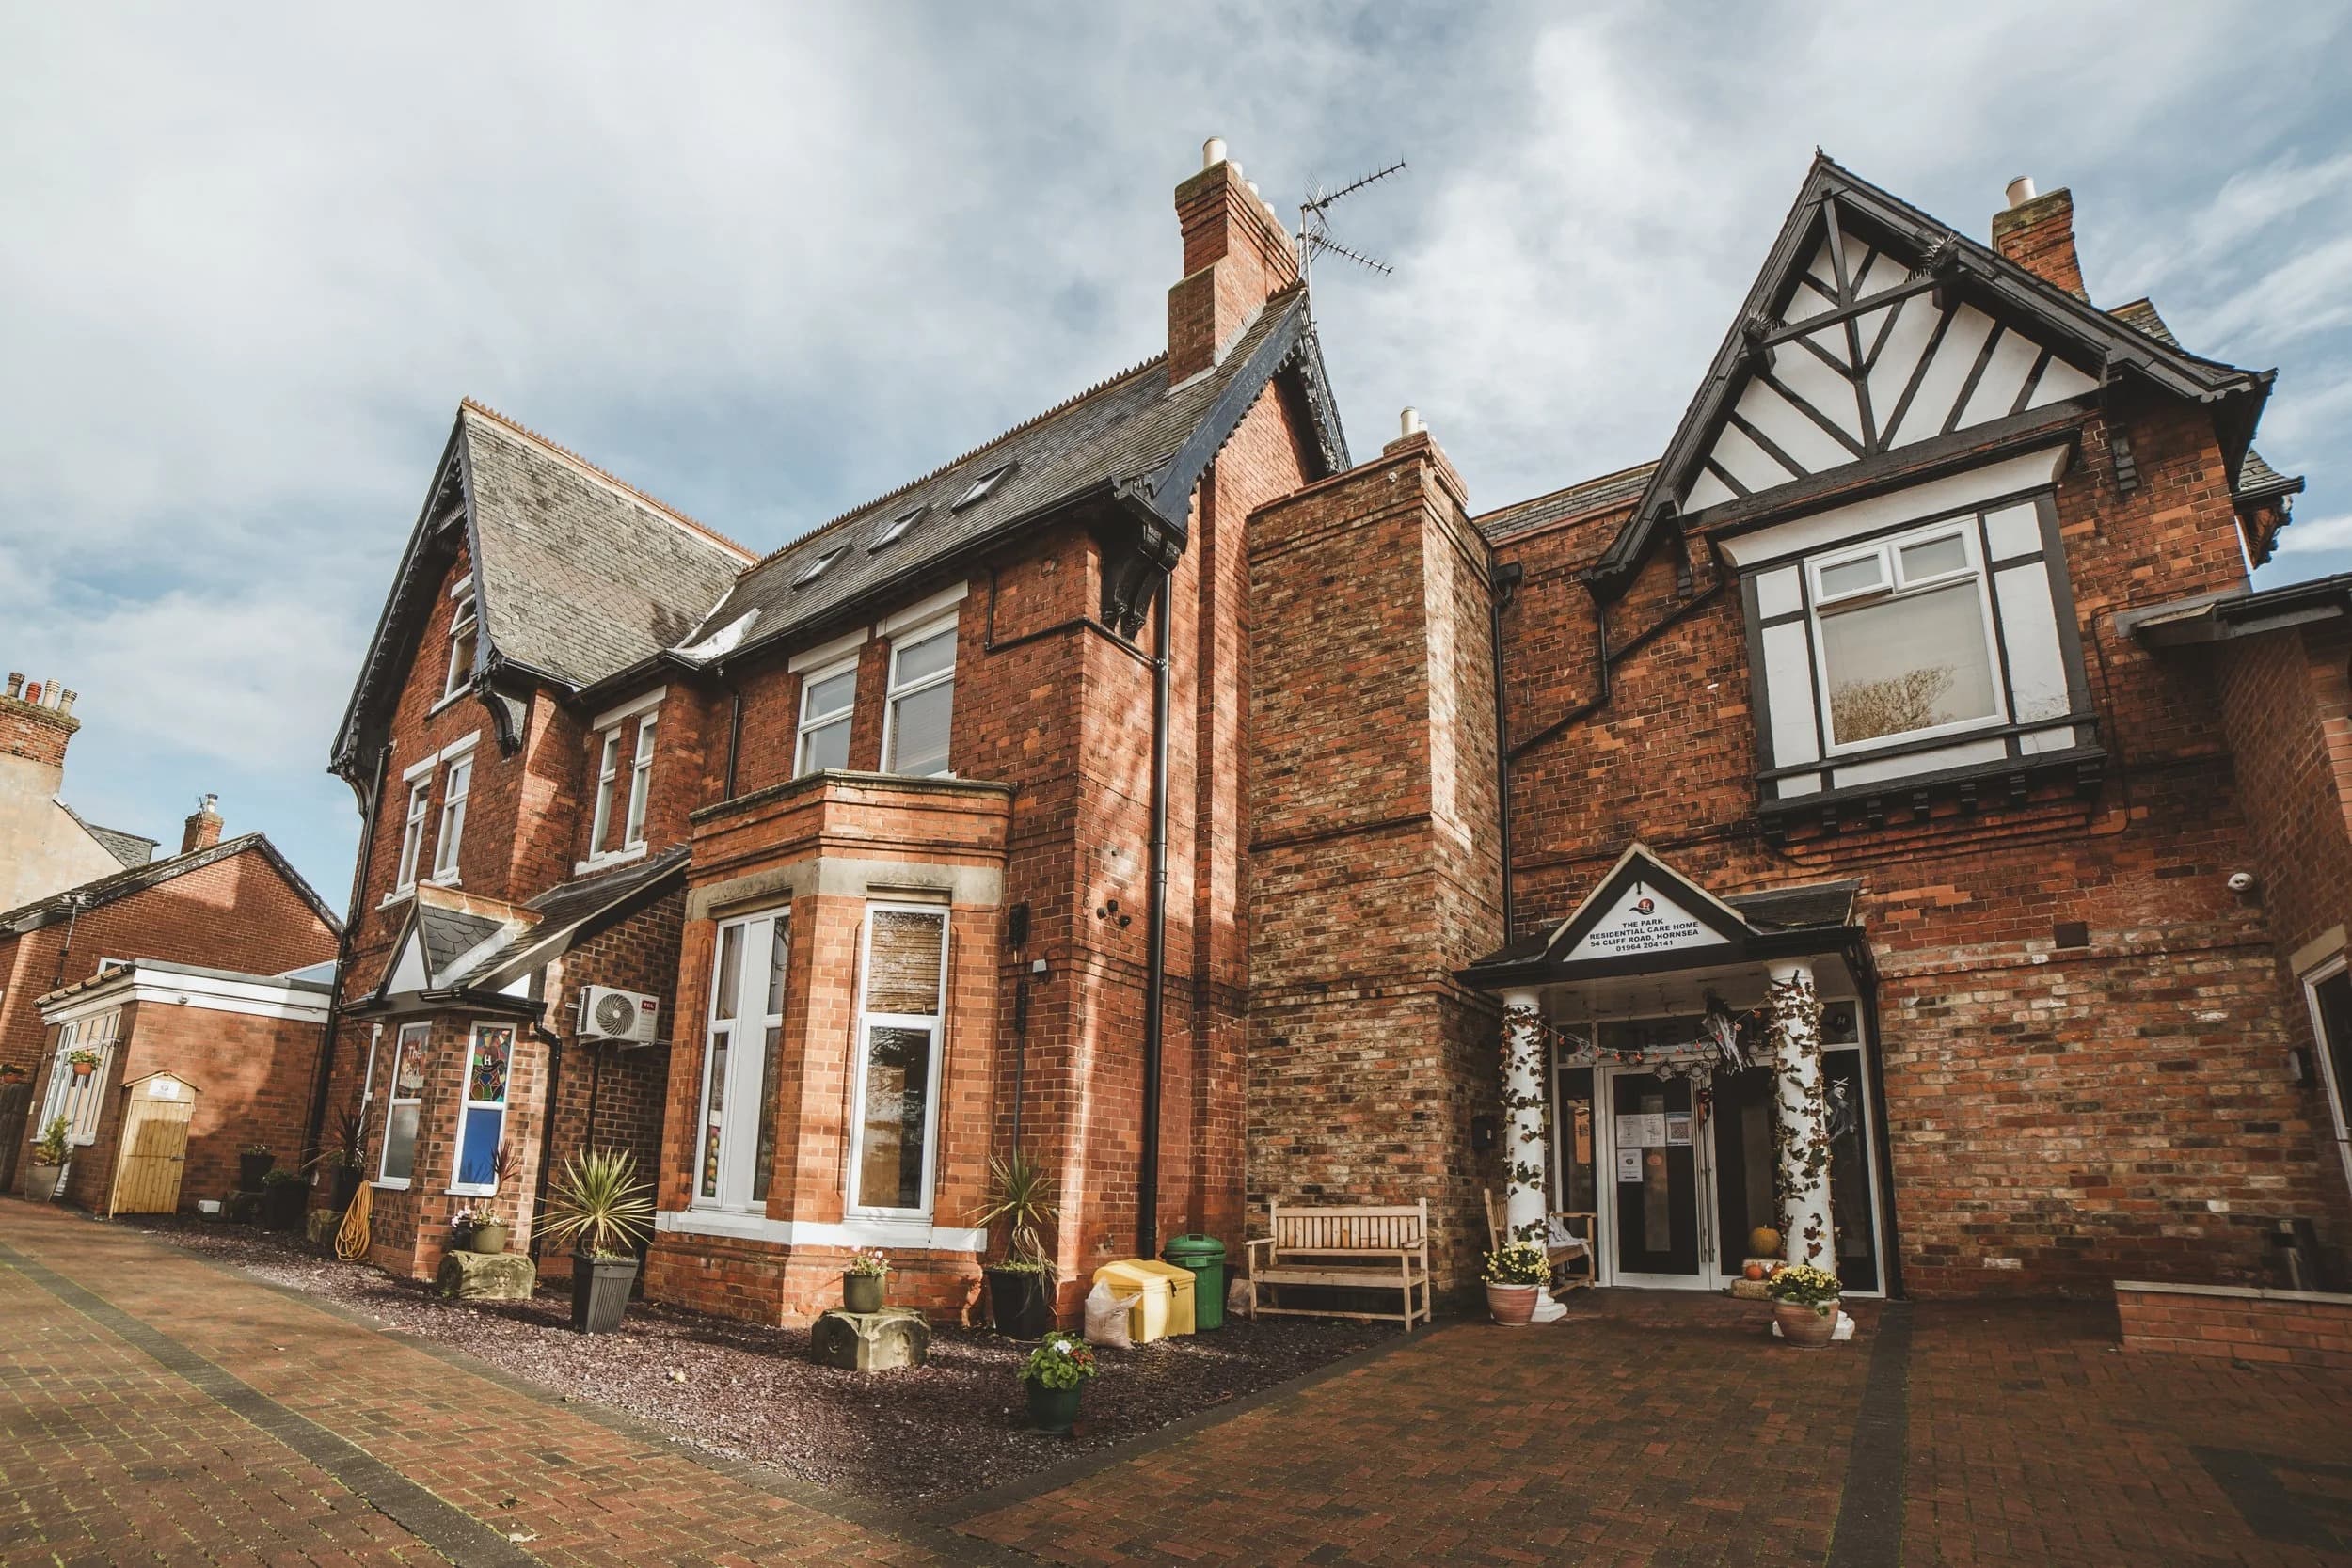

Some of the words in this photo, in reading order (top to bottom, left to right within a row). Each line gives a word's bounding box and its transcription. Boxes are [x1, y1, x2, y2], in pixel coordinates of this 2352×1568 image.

[1590, 928, 1645, 940] RESIDENTIAL
[1647, 925, 1671, 933] CARE
[1673, 921, 1699, 930] HOME
[1641, 918, 1663, 927] PARK
[1602, 937, 1627, 946] CLIFF
[1629, 935, 1654, 943] ROAD,
[1656, 928, 1699, 940] HORNSEA
[1615, 943, 1641, 952] 01964
[1643, 940, 1673, 949] 204141
[407, 1045, 422, 1061] The
